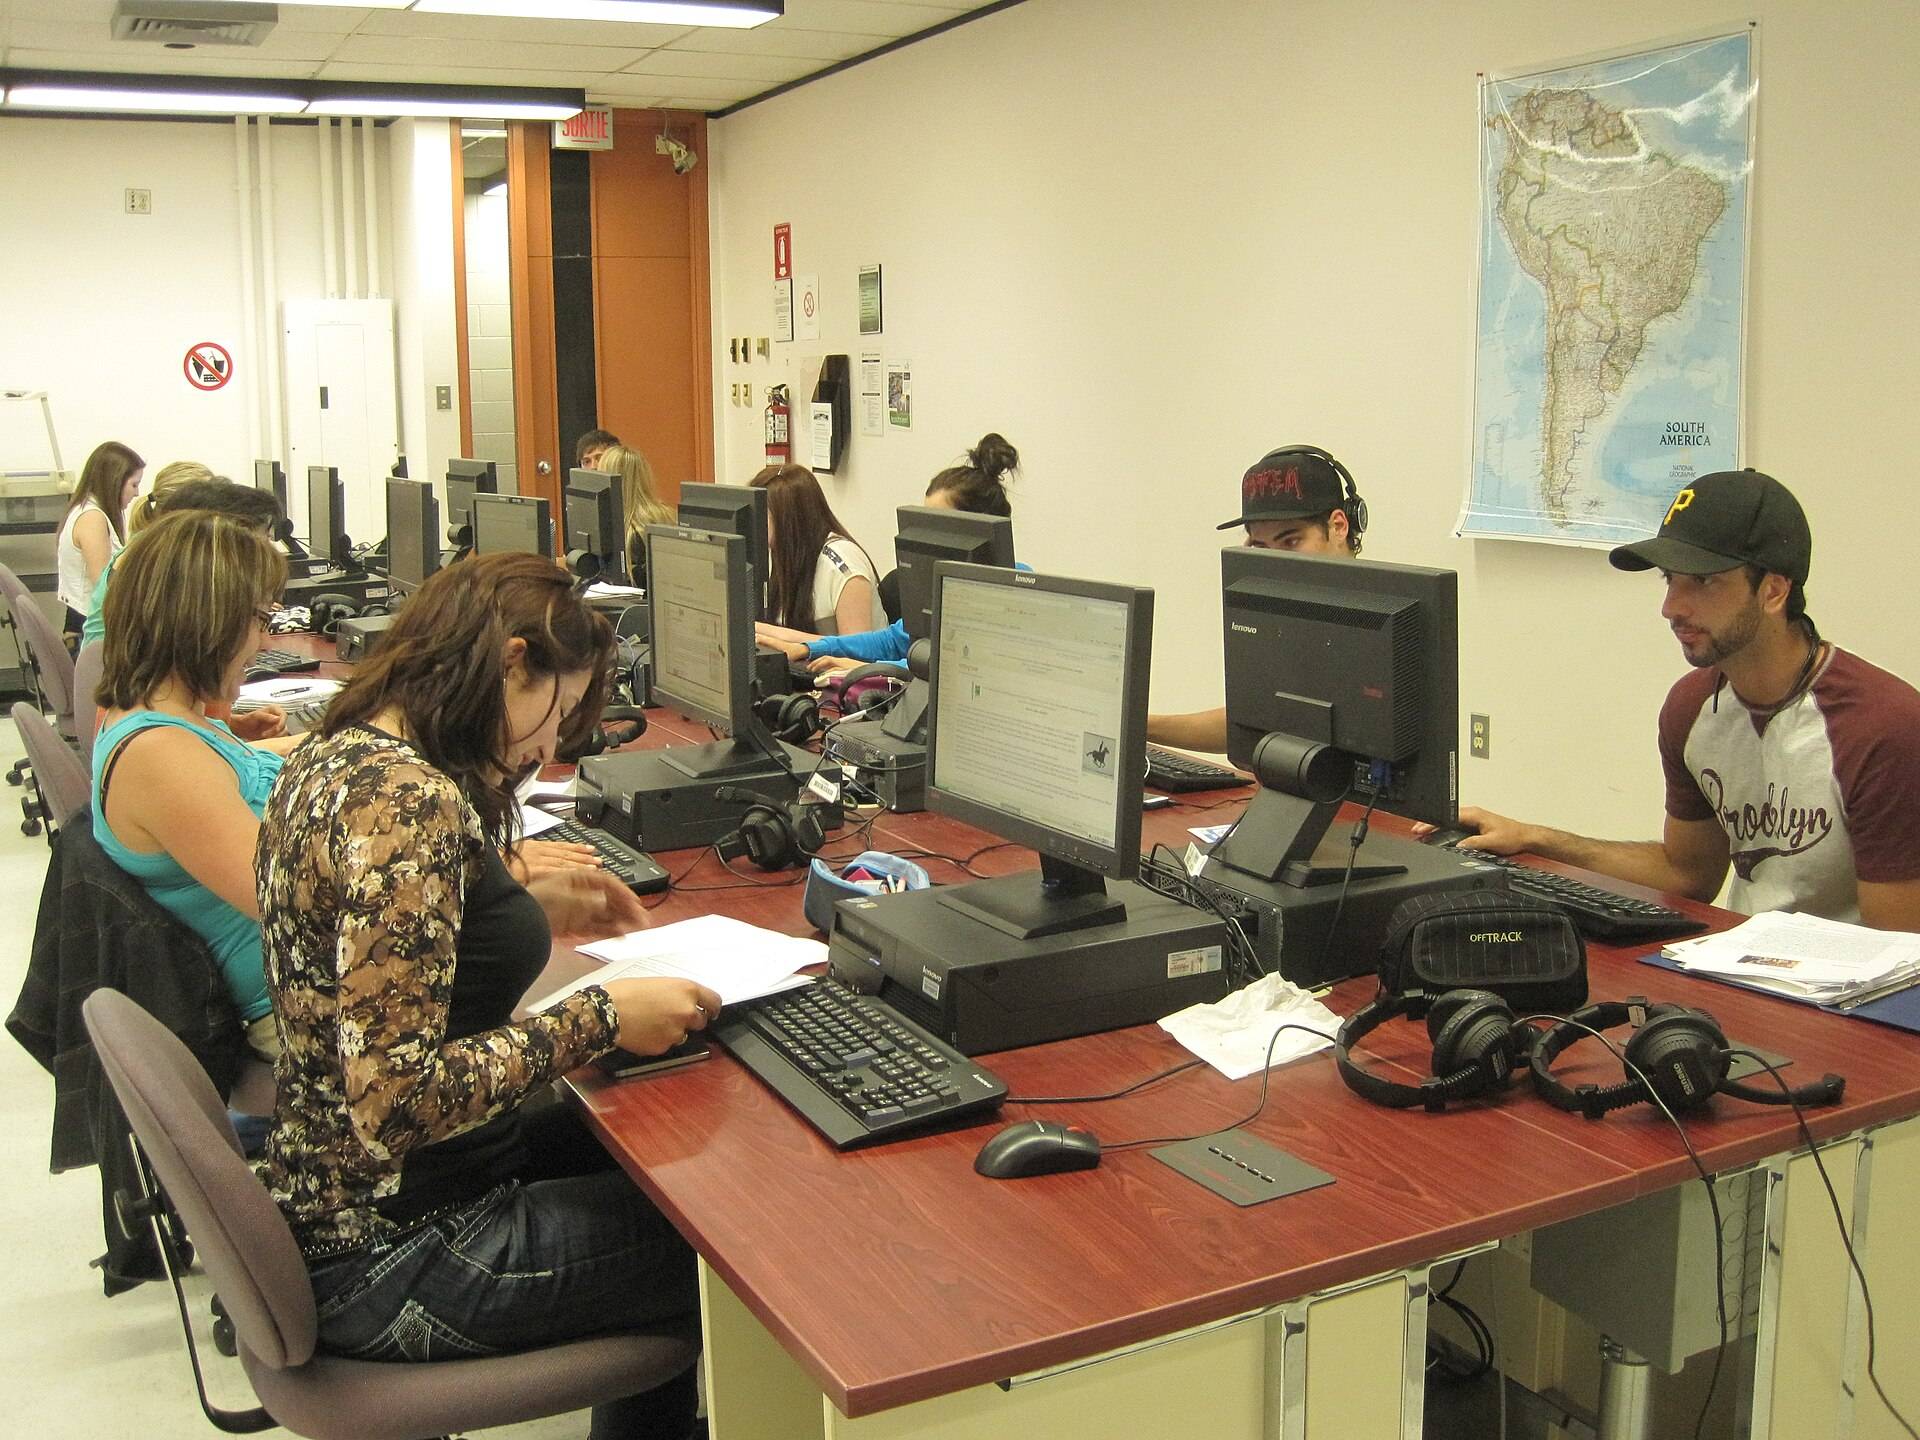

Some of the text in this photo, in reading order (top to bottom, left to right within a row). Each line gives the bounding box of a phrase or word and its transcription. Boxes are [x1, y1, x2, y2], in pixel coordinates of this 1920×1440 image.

[1665, 422, 1705, 433] SOUTH
[1659, 435, 1711, 446] AMERICA
[1663, 488, 1695, 525] P
[1014, 573, 1036, 585] lenovo
[1231, 620, 1257, 634] lenovo
[1469, 931, 1523, 943] OFFTRACK
